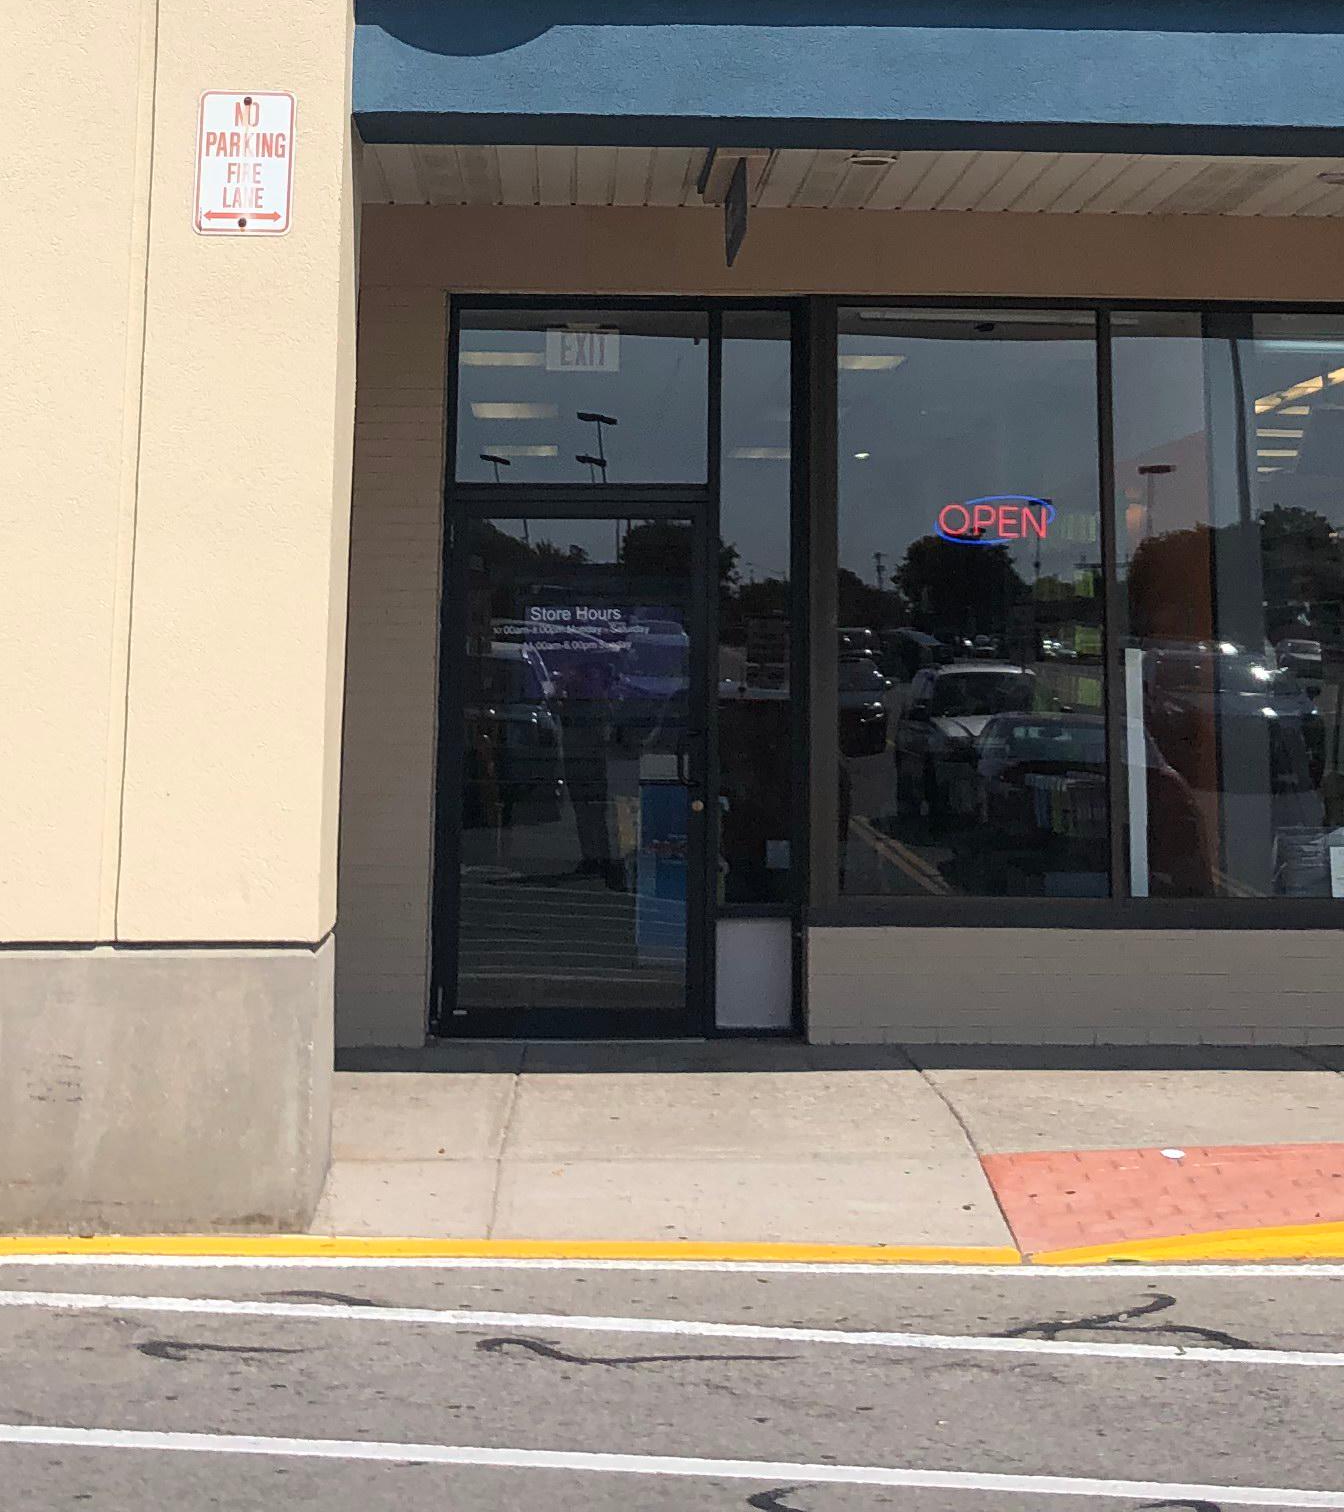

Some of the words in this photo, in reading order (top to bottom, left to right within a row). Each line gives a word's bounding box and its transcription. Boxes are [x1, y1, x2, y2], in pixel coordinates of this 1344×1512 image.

[234, 101, 260, 127] NO
[205, 131, 286, 158] PARKING
[560, 335, 605, 366] EXIT
[939, 503, 1047, 538] OPEN
[530, 606, 572, 621] Store
[575, 606, 622, 621] Hours
